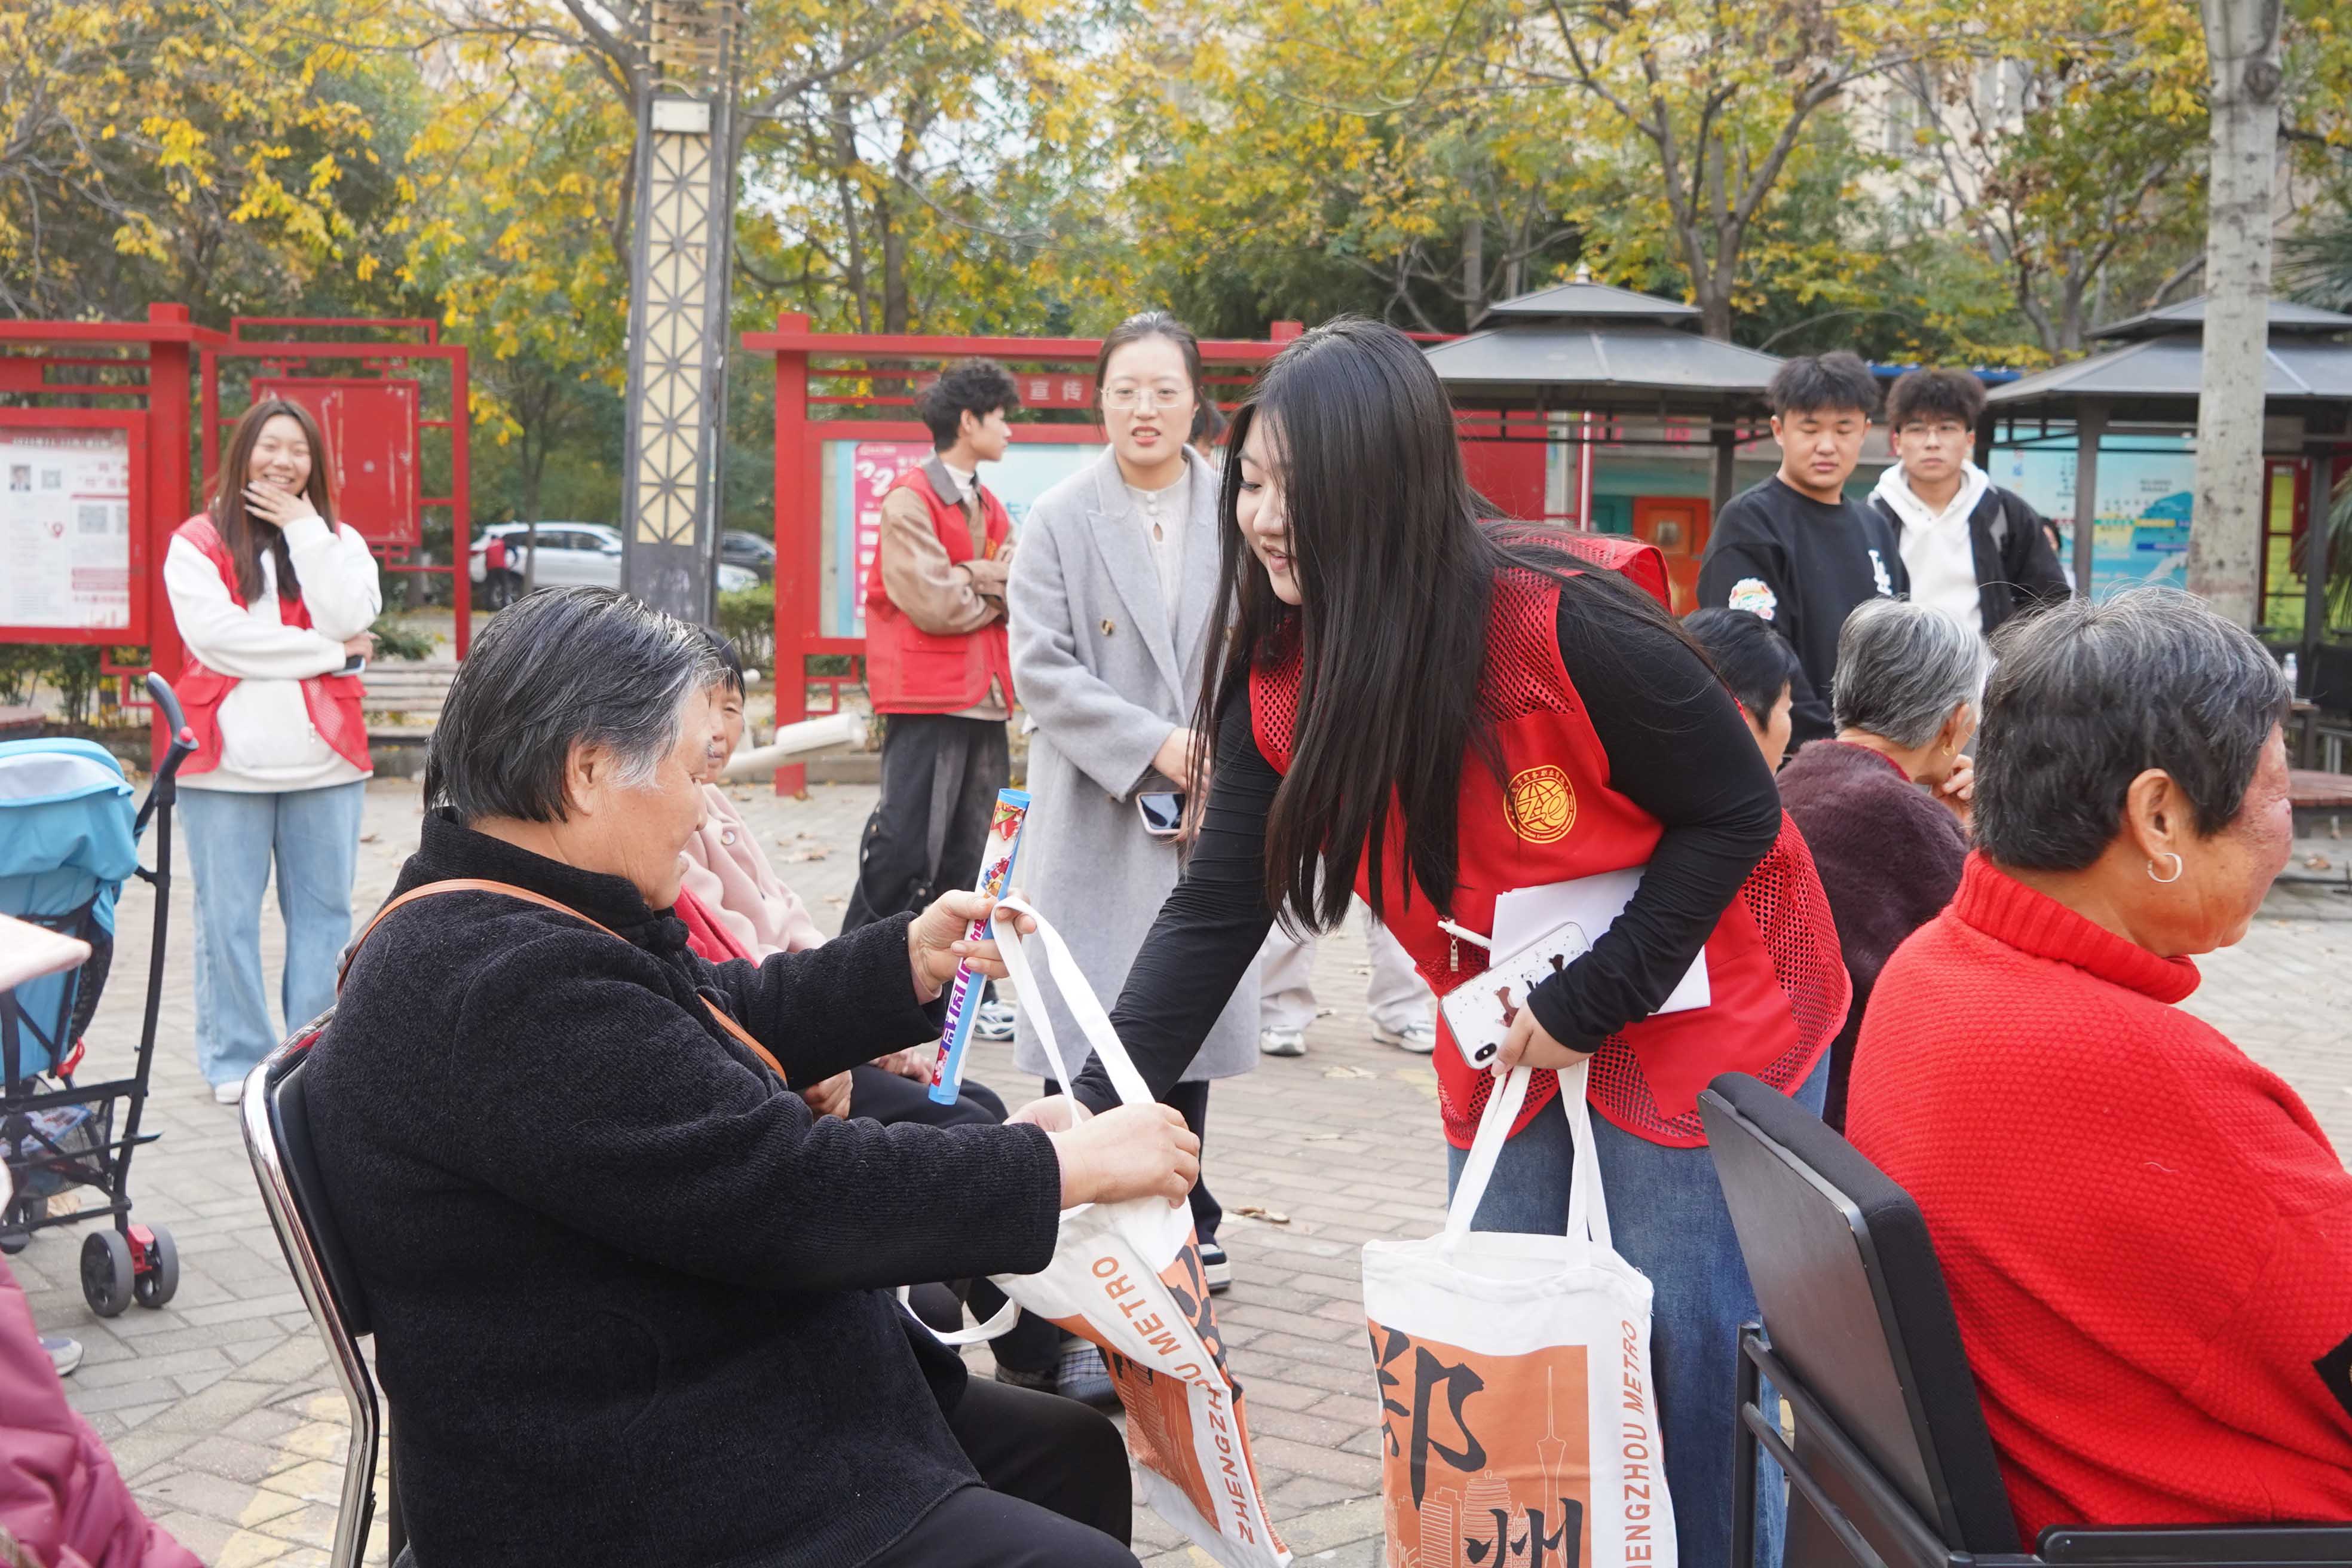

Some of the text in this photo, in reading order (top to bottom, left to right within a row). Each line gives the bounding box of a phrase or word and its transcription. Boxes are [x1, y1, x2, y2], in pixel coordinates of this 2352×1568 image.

[1028, 380, 1083, 401] 宣传
[1092, 1255, 1181, 1356] METRO
[1621, 1319, 1645, 1415] METRO
[1622, 1423, 1652, 1568] ENGZHOU
